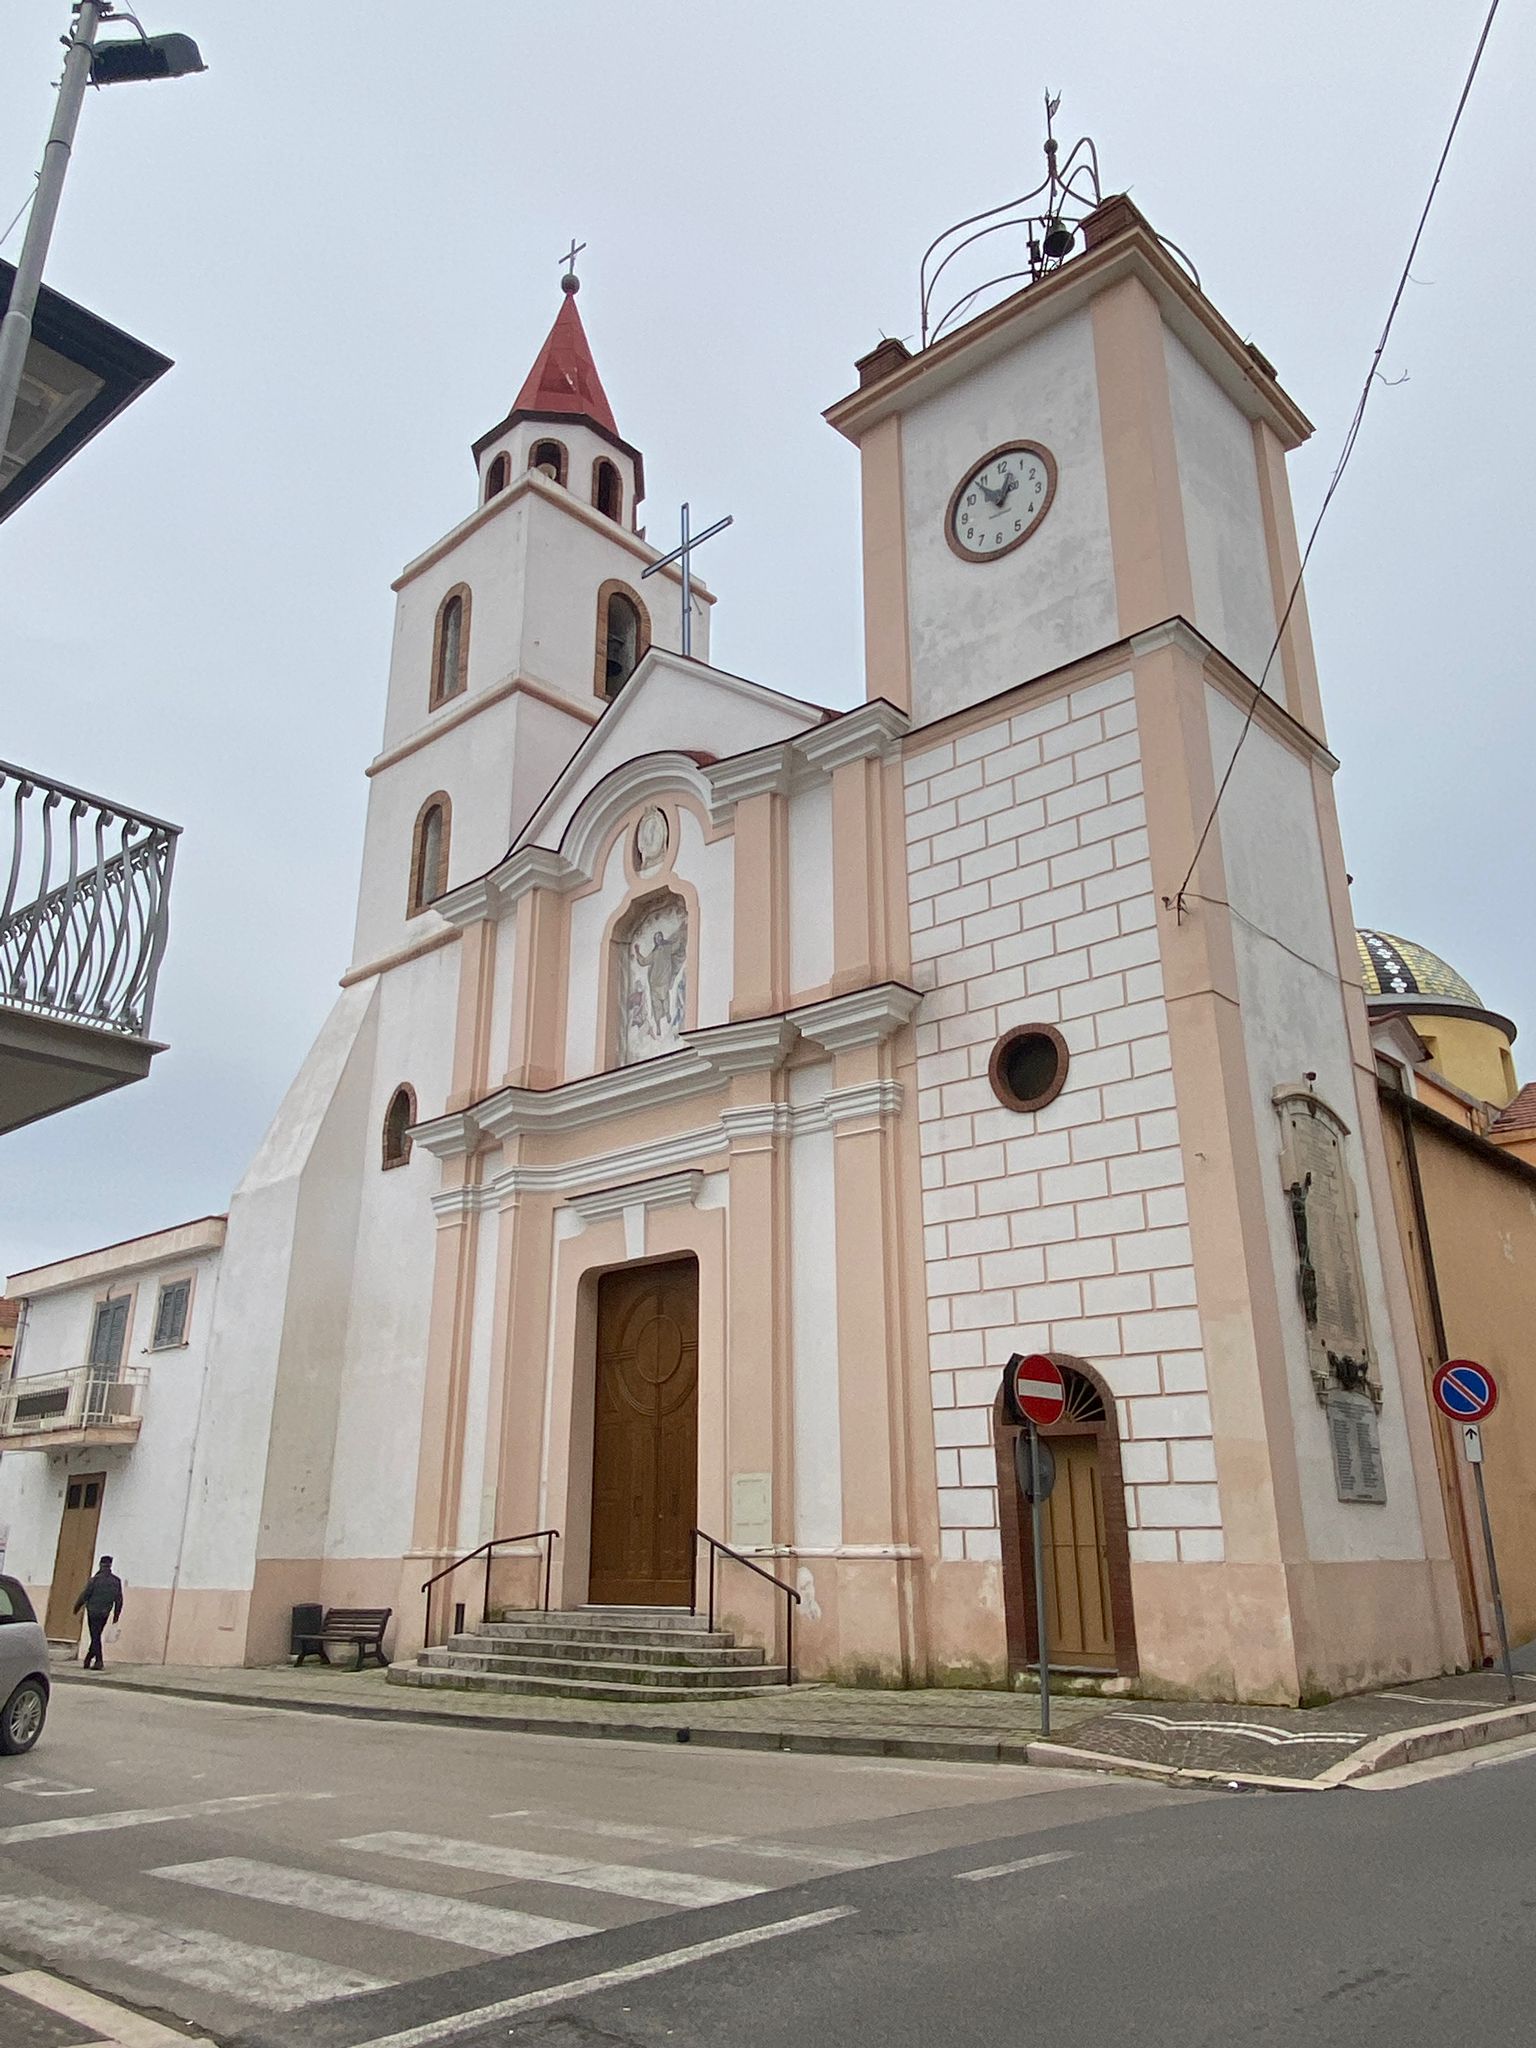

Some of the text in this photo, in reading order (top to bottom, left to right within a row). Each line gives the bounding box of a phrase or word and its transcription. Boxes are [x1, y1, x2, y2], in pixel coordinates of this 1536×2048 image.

[997, 461, 1008, 474] 12
[1019, 459, 1024, 471] 1
[980, 474, 988, 486] 11
[1029, 468, 1036, 481] 2
[1035, 482, 1042, 494] 3
[966, 494, 977, 507] 10
[1027, 501, 1034, 513] 4
[961, 513, 969, 525] 9
[1014, 519, 1022, 532] 5
[967, 527, 974, 540] 8
[996, 532, 1003, 545] 6
[978, 534, 985, 547] 7
